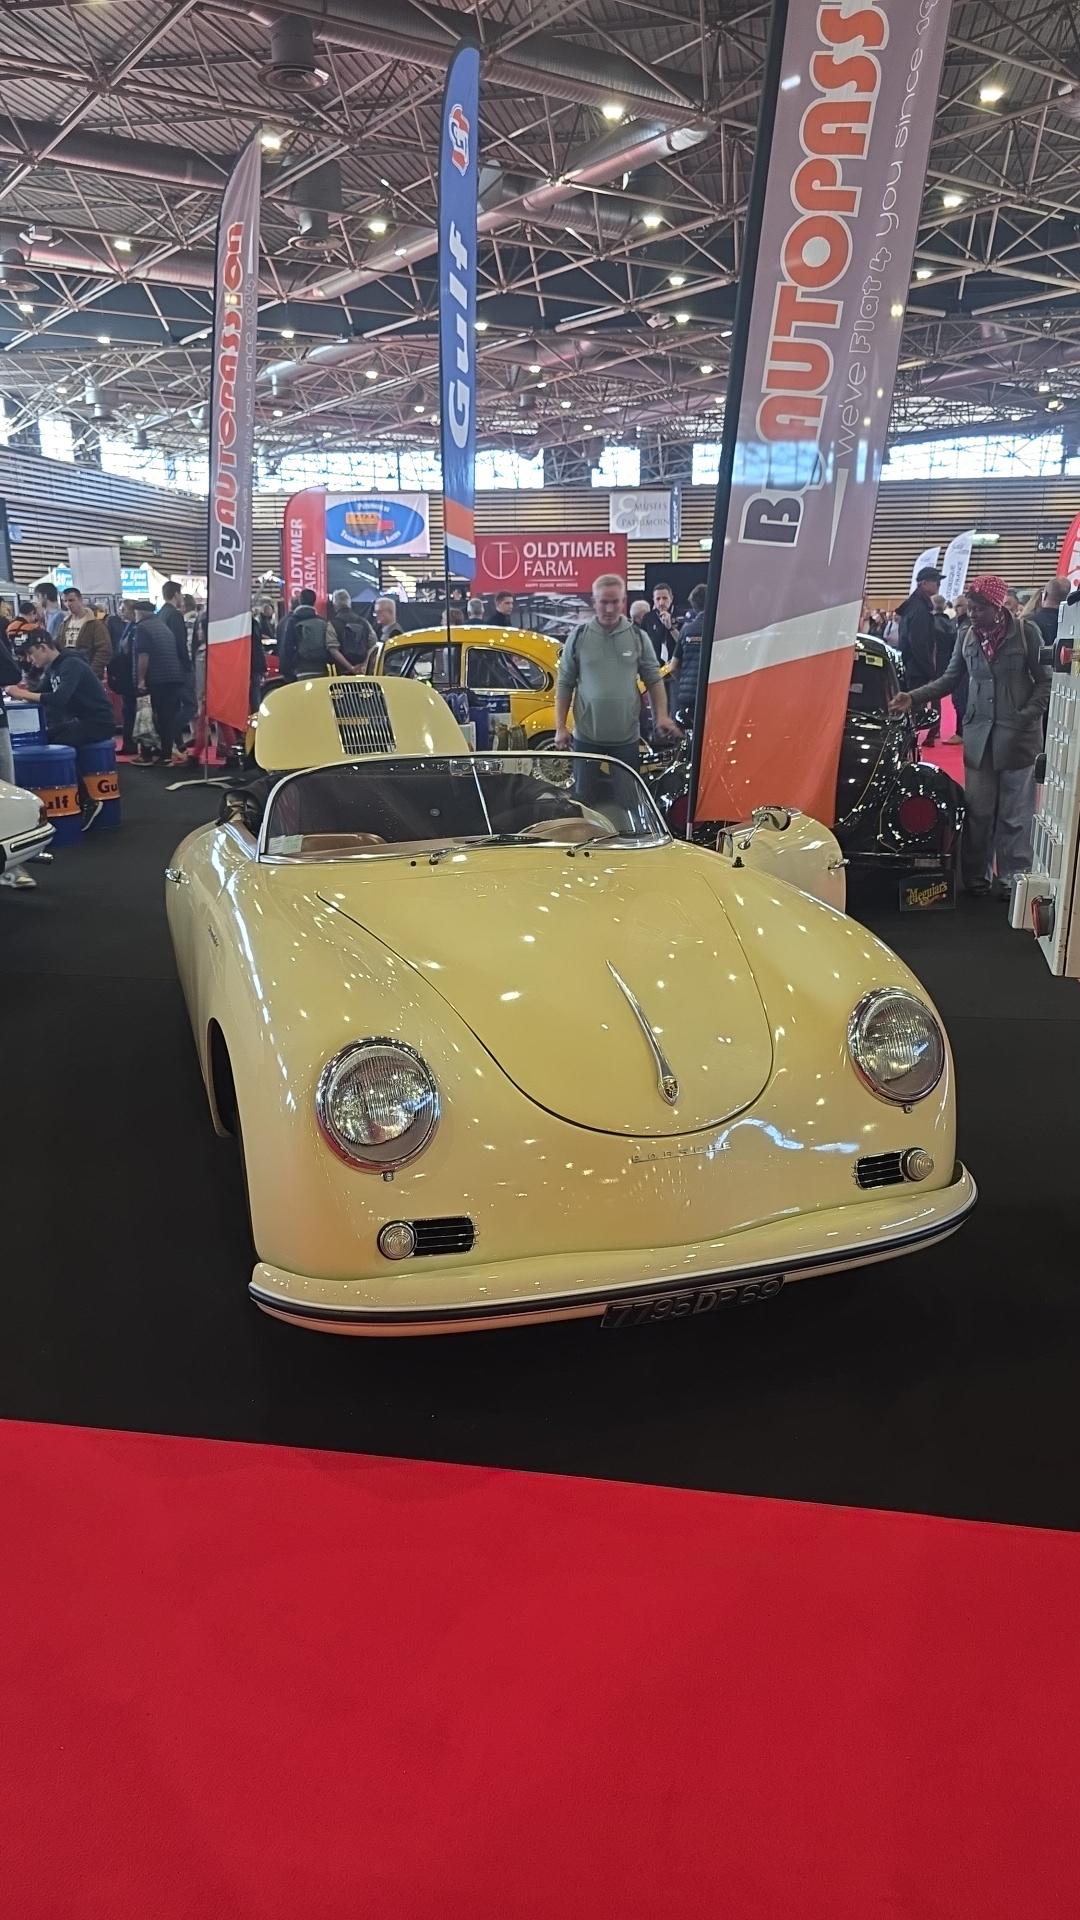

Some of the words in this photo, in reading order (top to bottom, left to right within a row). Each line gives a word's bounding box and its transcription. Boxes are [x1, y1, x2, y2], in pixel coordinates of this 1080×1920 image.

[849, 276, 882, 354] Flat
[876, 160, 903, 238] you
[895, 48, 923, 149] since
[738, 0, 890, 548] ByAUTOPASS
[449, 220, 471, 448] Gulf
[290, 518, 303, 599] OLDTIMER
[523, 541, 616, 558] OLDTIMER
[1038, 541, 1056, 550] 6.42
[304, 551, 317, 592] ARM.
[524, 560, 579, 577] FARM.
[47, 795, 69, 810] ulf
[631, 1141, 731, 1163] PORSCHE
